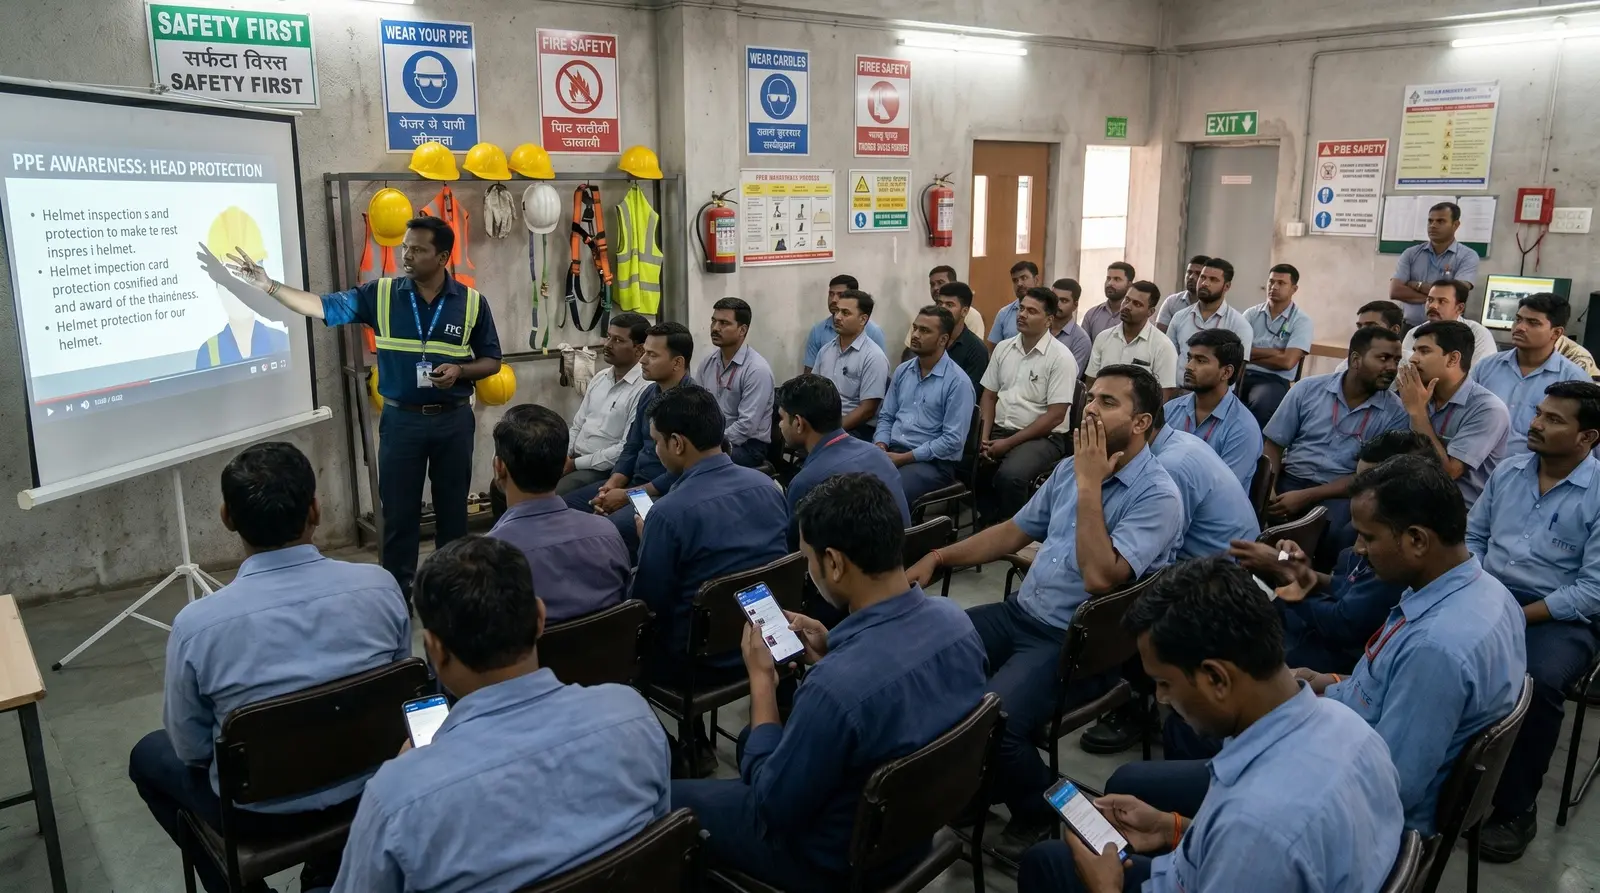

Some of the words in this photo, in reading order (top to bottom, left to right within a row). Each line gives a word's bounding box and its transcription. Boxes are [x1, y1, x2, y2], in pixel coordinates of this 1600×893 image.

[157, 11, 239, 38] SAFETY
[246, 17, 304, 42] FIRST
[385, 25, 416, 41] WEAR
[418, 27, 446, 43] YOUR
[449, 29, 469, 44] PPE
[542, 37, 567, 52] FIRE
[570, 39, 613, 54] SAFETY
[750, 53, 772, 66] WEAR
[882, 63, 909, 75] SAFETY
[171, 73, 245, 92] SAFETY
[251, 76, 303, 95] FIRST
[1207, 116, 1239, 133] EXIT
[12, 153, 45, 171] PPE
[50, 155, 147, 174] AWARENESS:
[150, 159, 187, 176] HEAD
[190, 161, 263, 178] PROTECTION
[42, 209, 85, 221] Helmet
[88, 208, 142, 222] inspection
[151, 208, 169, 219] and
[45, 227, 104, 242] protection
[106, 228, 118, 237] to
[120, 225, 147, 237] make
[149, 226, 158, 235] te
[161, 225, 178, 235] rest
[47, 247, 88, 260] inspres
[96, 243, 136, 255] helmet.
[49, 264, 92, 277] Helmet
[94, 261, 146, 275] impection
[148, 259, 169, 270] card
[52, 280, 111, 298] protection
[161, 274, 178, 286] and
[54, 300, 76, 314] and
[79, 297, 113, 311] award
[116, 295, 126, 308] of
[129, 294, 145, 306] the
[57, 318, 98, 332] Helmet
[101, 312, 152, 329] protection
[155, 309, 168, 320] for
[170, 308, 185, 318] our
[445, 323, 462, 335] FPC
[59, 336, 102, 350] helmet.
